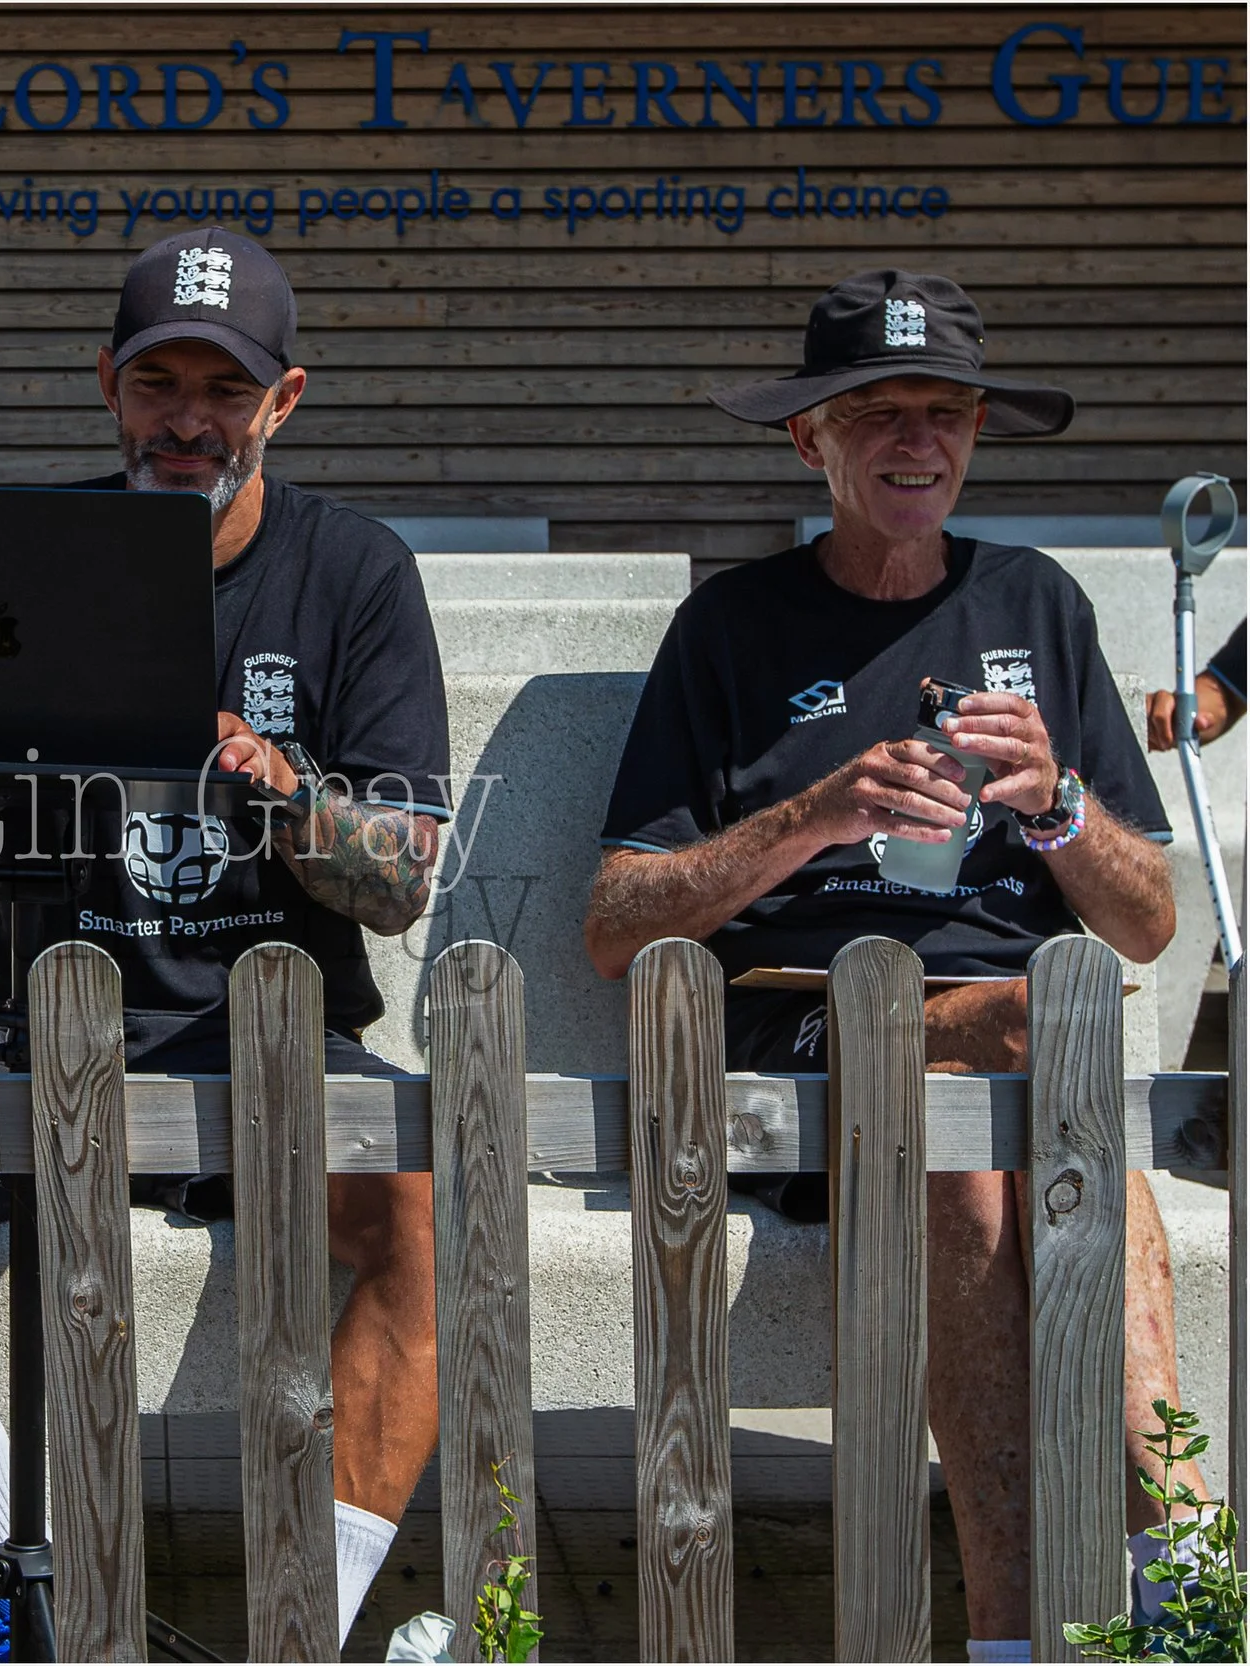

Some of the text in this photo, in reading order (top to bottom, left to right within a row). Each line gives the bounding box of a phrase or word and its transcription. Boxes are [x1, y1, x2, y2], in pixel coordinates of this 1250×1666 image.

[337, 30, 943, 129] TAVERNERS
[991, 22, 1247, 127] GUE
[121, 188, 275, 237] young
[298, 168, 472, 235] people
[490, 186, 522, 220] a
[542, 176, 746, 233] sporting
[766, 166, 950, 219] chance
[244, 652, 298, 668] GUERNSEY
[980, 649, 1032, 662] GUERNSEY
[790, 705, 847, 724] MASURI
[824, 876, 912, 895] Smarter
[79, 909, 285, 938] Smarter Payments
